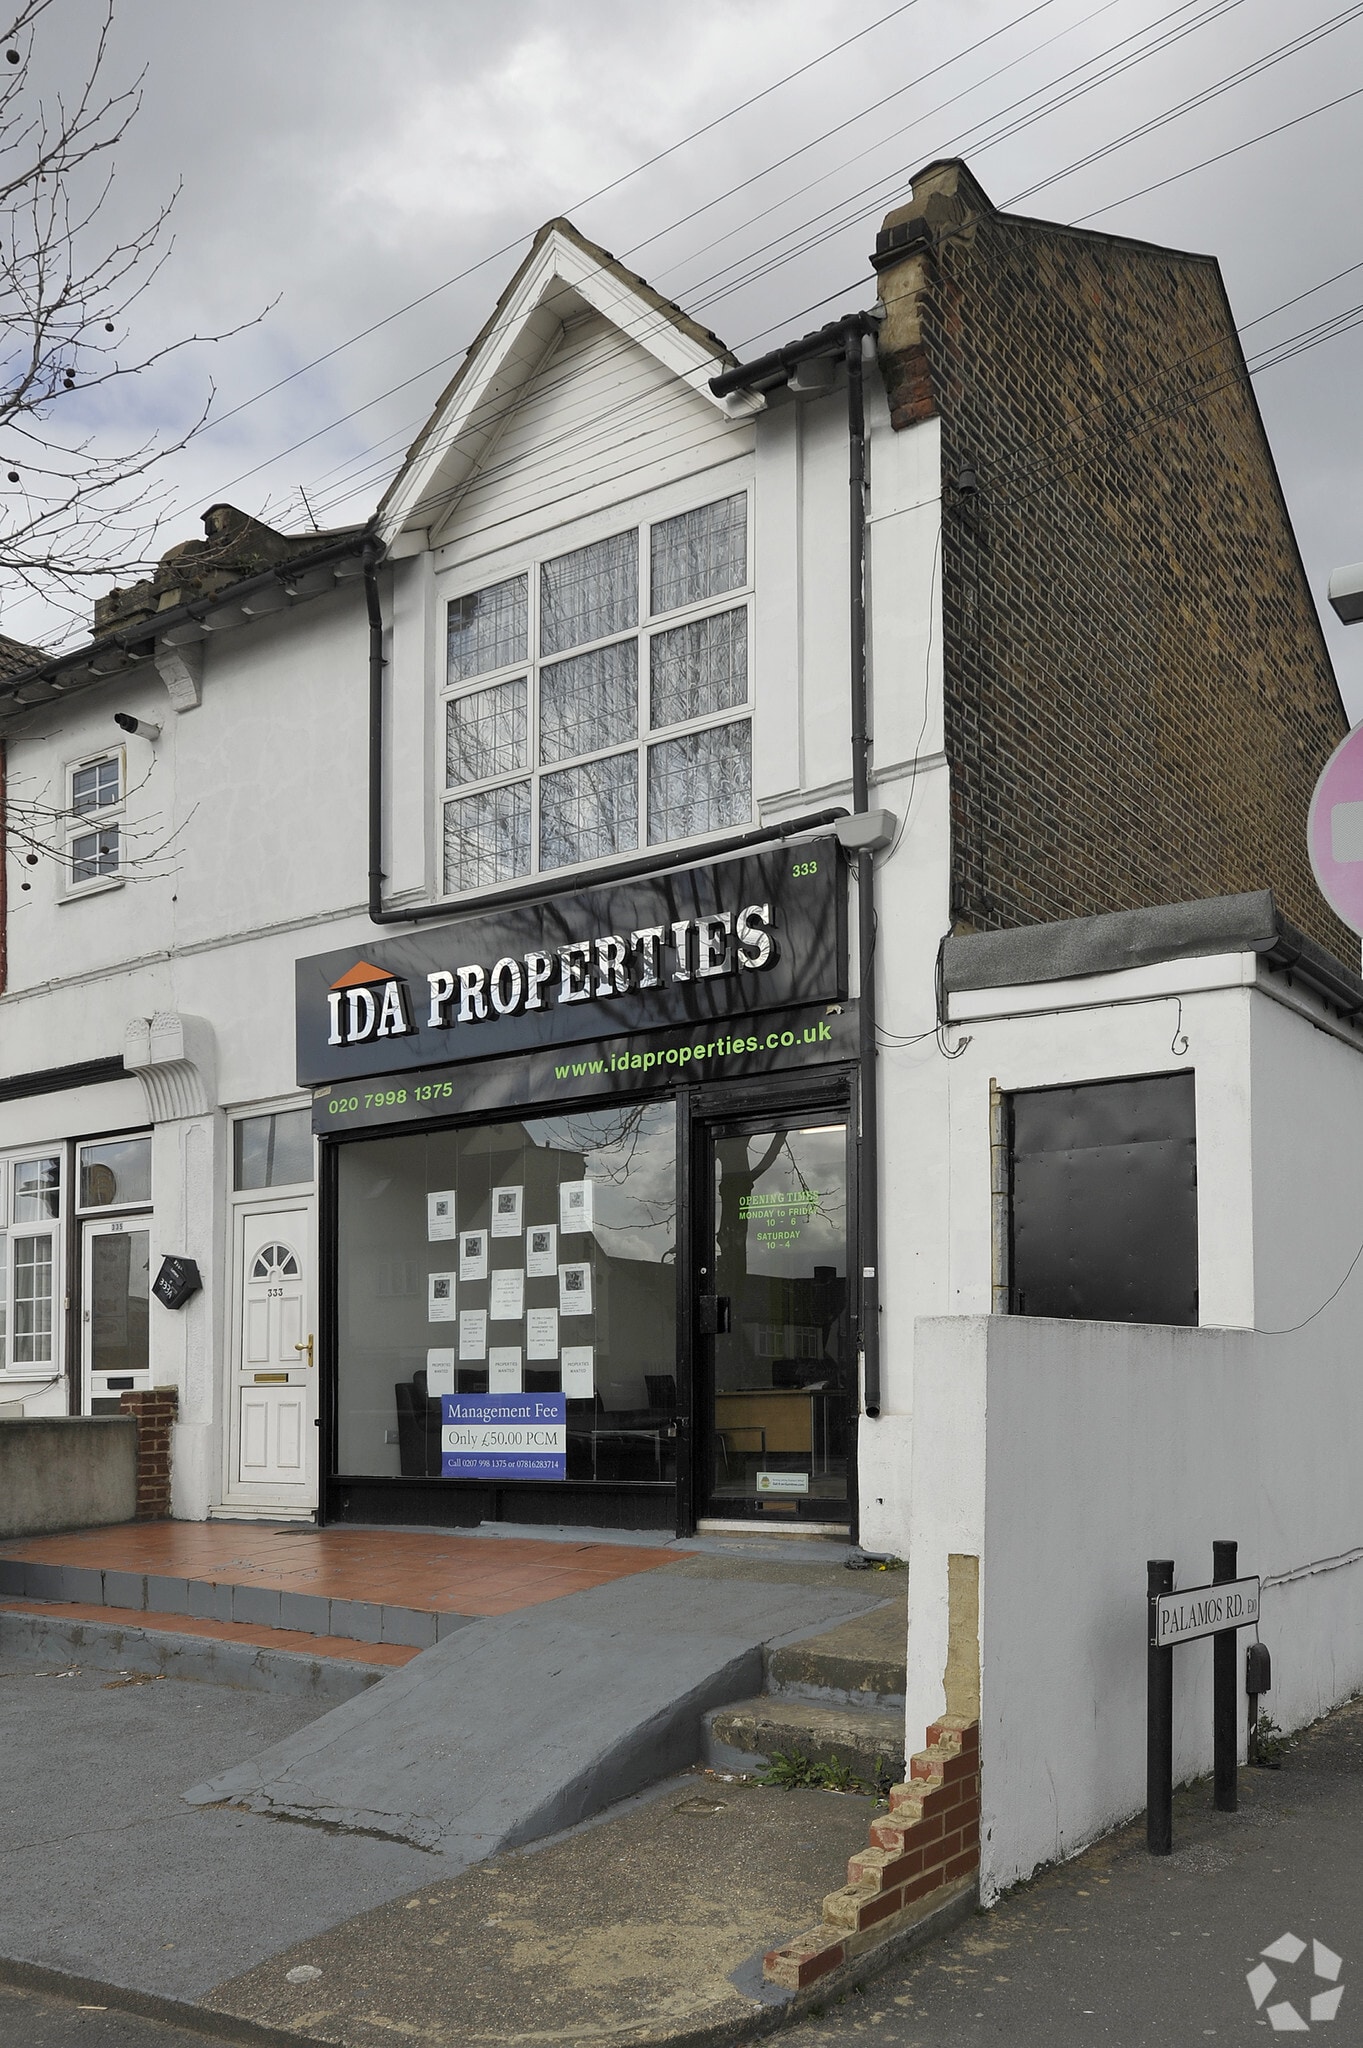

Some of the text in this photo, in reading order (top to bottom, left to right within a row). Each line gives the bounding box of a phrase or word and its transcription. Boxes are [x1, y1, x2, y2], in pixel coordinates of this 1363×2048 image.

[792, 861, 818, 878] 333
[426, 903, 777, 1028] PROPERTIES
[326, 980, 409, 1046] IDA
[554, 1021, 832, 1080] www.idaproperties.co.uk
[328, 1082, 453, 1114] 020 7998 1375
[739, 1190, 820, 1206] OPENING TIMES
[739, 1206, 818, 1220] MONDAY to FRIDAY
[766, 1218, 776, 1227] 10
[790, 1217, 797, 1226] 6
[756, 1230, 801, 1241] SATURDAY
[766, 1241, 776, 1249] 10
[784, 1240, 791, 1249] 4
[267, 1288, 284, 1298] 333
[448, 1403, 558, 1423] Management Fee
[448, 1430, 558, 1449] Only £50.00 PCM
[448, 1458, 461, 1468] Call
[462, 1459, 478, 1468] 0207
[479, 1459, 490, 1468] 998
[492, 1459, 507, 1468] 1375
[1161, 1597, 1223, 1636] PALAMOS
[1226, 1593, 1244, 1619] RD.
